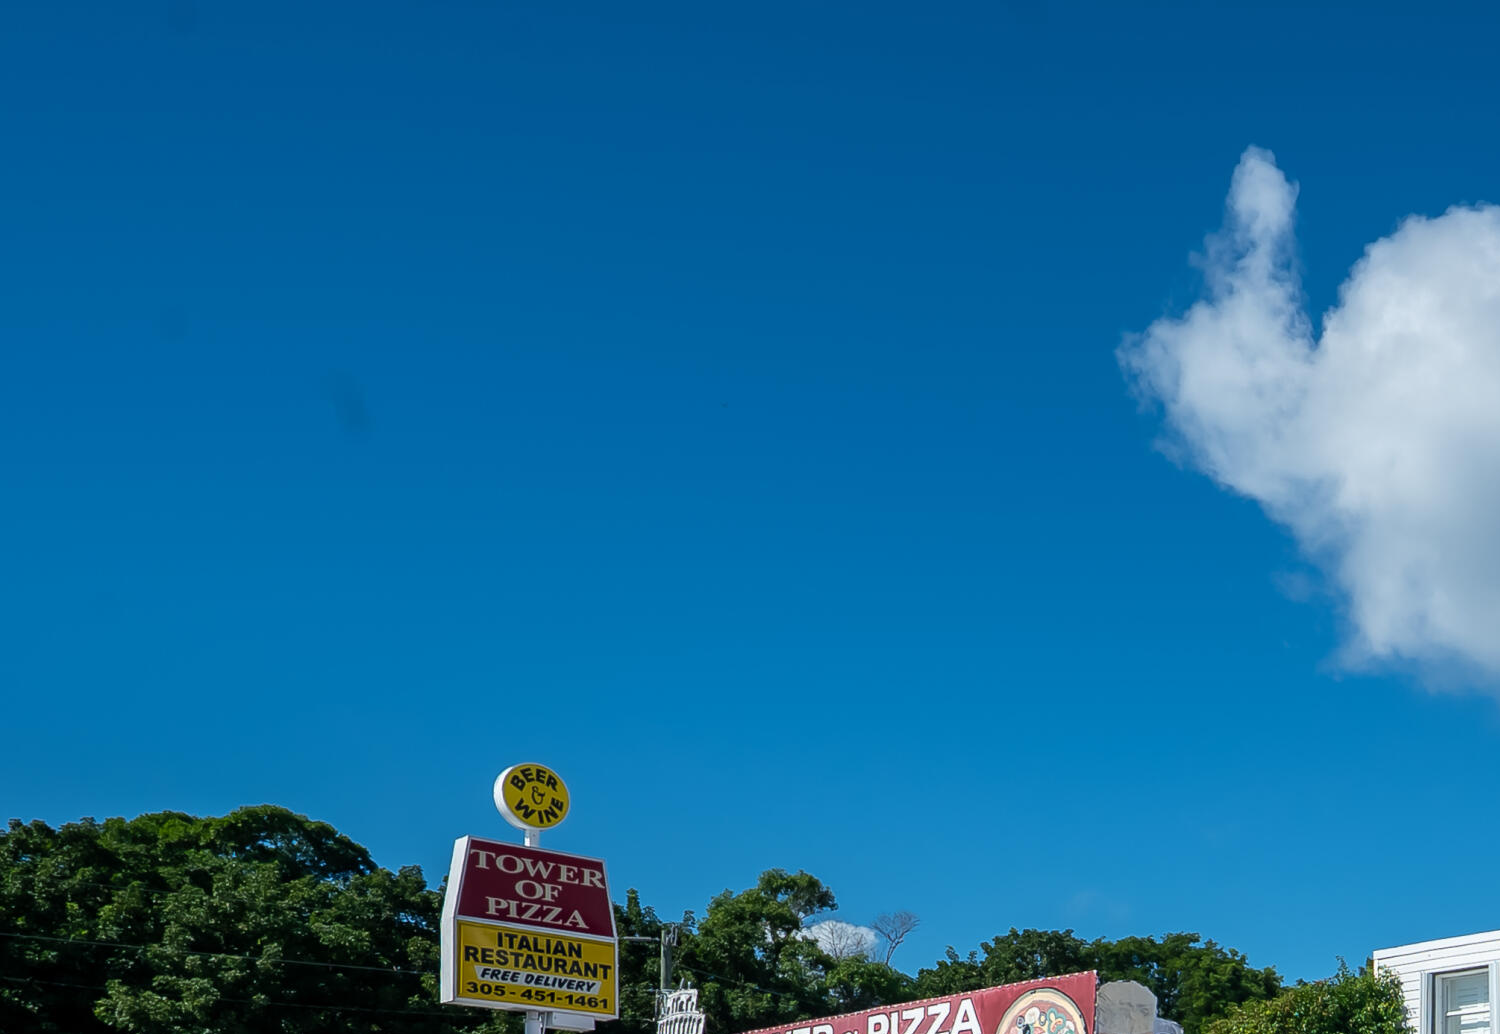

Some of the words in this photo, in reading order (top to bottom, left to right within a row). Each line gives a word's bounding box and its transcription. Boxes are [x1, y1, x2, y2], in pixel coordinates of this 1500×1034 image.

[510, 767, 558, 792] BEER
[531, 785, 545, 805] &
[515, 797, 563, 825] WINE
[470, 849, 605, 889] TOWER
[515, 880, 562, 902] OF
[485, 896, 589, 929] PIZZA
[497, 931, 582, 959] ITALIAN
[464, 945, 612, 980] RESTAURANT
[480, 968, 519, 983] FREE
[524, 973, 596, 993] DELIVERY
